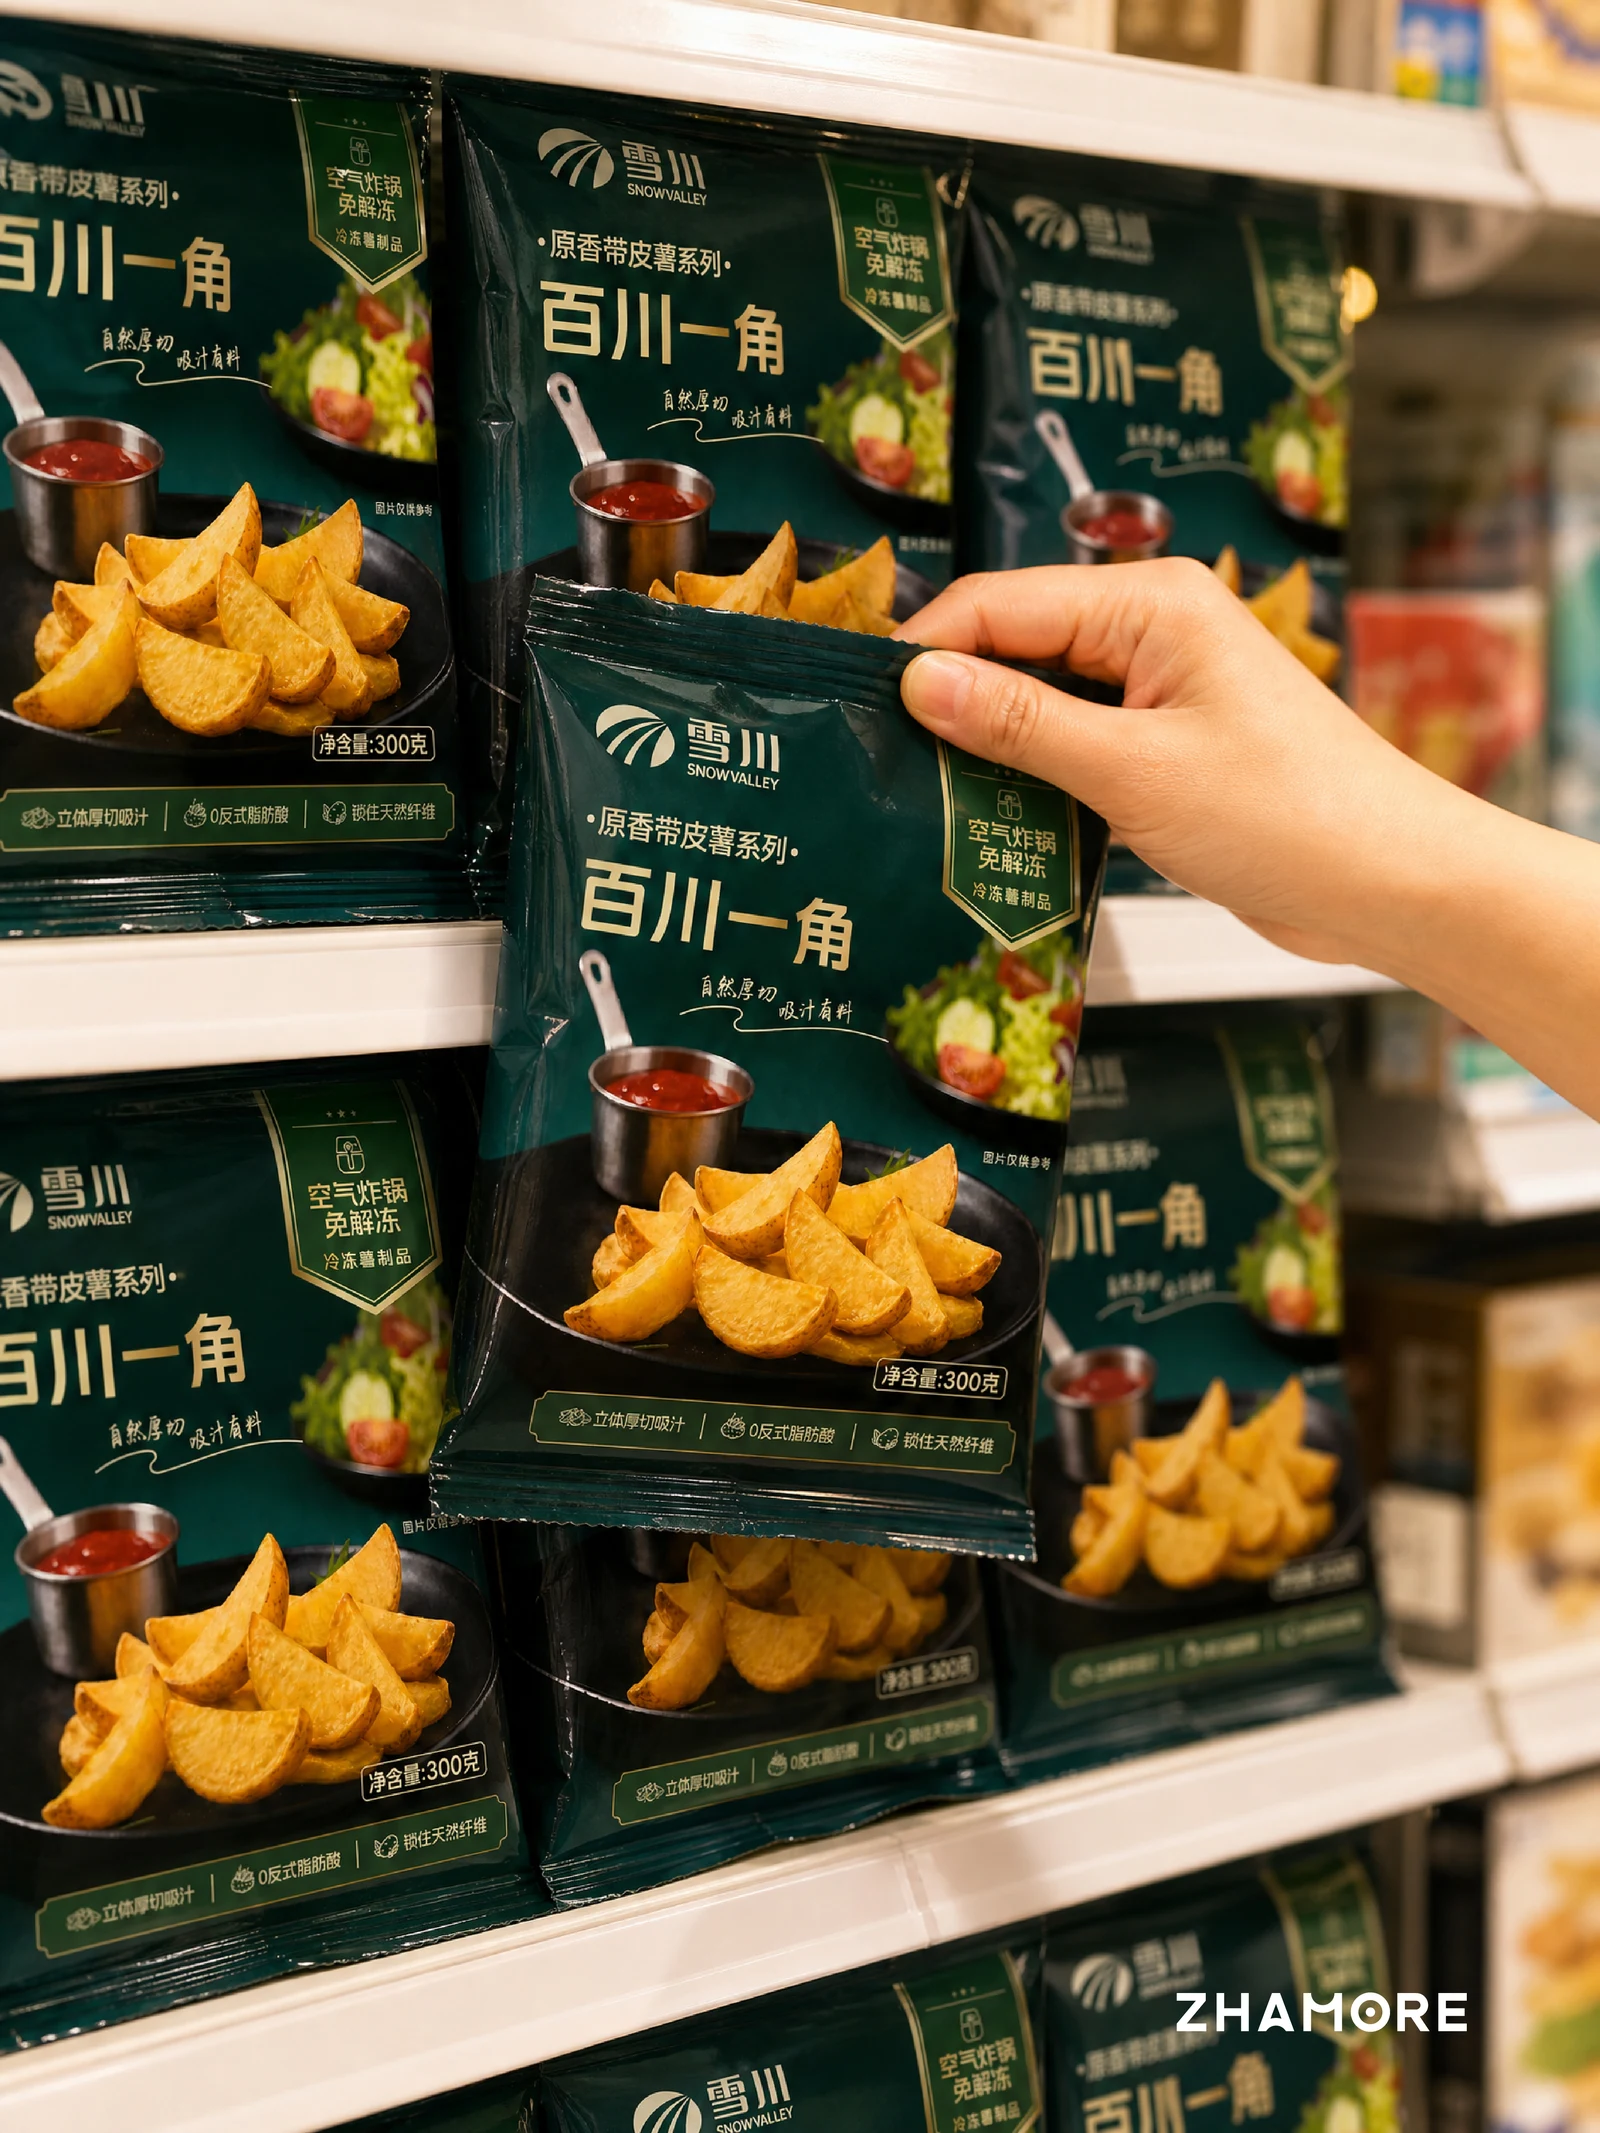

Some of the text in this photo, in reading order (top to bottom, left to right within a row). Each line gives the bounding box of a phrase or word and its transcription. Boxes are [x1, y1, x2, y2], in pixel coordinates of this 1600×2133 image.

[621, 139, 706, 189] 雪川
[326, 166, 403, 198] 空气炸锅
[627, 183, 707, 206] SNOWVALLEY
[339, 192, 397, 222] 免解冻
[335, 228, 403, 253] 冷冻薯制品
[866, 251, 924, 283] 免解冻
[539, 280, 785, 376] 百川一角
[1026, 327, 1223, 416] 百川一角
[663, 388, 729, 412] 自然厚切
[731, 404, 792, 429] 吸汁有料
[319, 733, 429, 757] 净含量:300克
[687, 717, 780, 773] 雪川
[687, 762, 780, 791] SNOWVALLEY
[57, 802, 436, 828] 立体厚切吸汁 0反式脂肪酸 锁住天然纤维
[967, 818, 1057, 856] 空气炸锅
[978, 846, 1047, 879] 免解冻
[972, 881, 1052, 911] 冷冻薯制品
[580, 858, 853, 971] 百川一角
[701, 977, 777, 1003] 自然厚切
[778, 1000, 853, 1023] 吸汁有料
[41, 1164, 130, 1212] 雪川
[308, 1178, 409, 1210] 空气炸锅
[48, 1211, 133, 1230] SNOWVALLEY
[325, 1207, 402, 1239] 免解冻
[1052, 1182, 1206, 1260] 川一角
[323, 1248, 412, 1271] 冷冻薯制品
[881, 1366, 999, 1395] 净含量:300克
[108, 1417, 185, 1448] 自然厚切
[189, 1410, 262, 1450] 吸汁有料
[593, 1411, 994, 1454] 立体厚切吸汁 0反式脂肪酸 锁住天然纤维
[368, 1750, 481, 1794] 净含量:300克
[101, 1817, 488, 1923] 立体厚切吸汁 0反式脂肪酸 锁住天然纤维
[939, 2036, 1017, 2079] 空气炸锅
[707, 2064, 791, 2120] 雪川
[954, 2066, 1012, 2104] 免解冻
